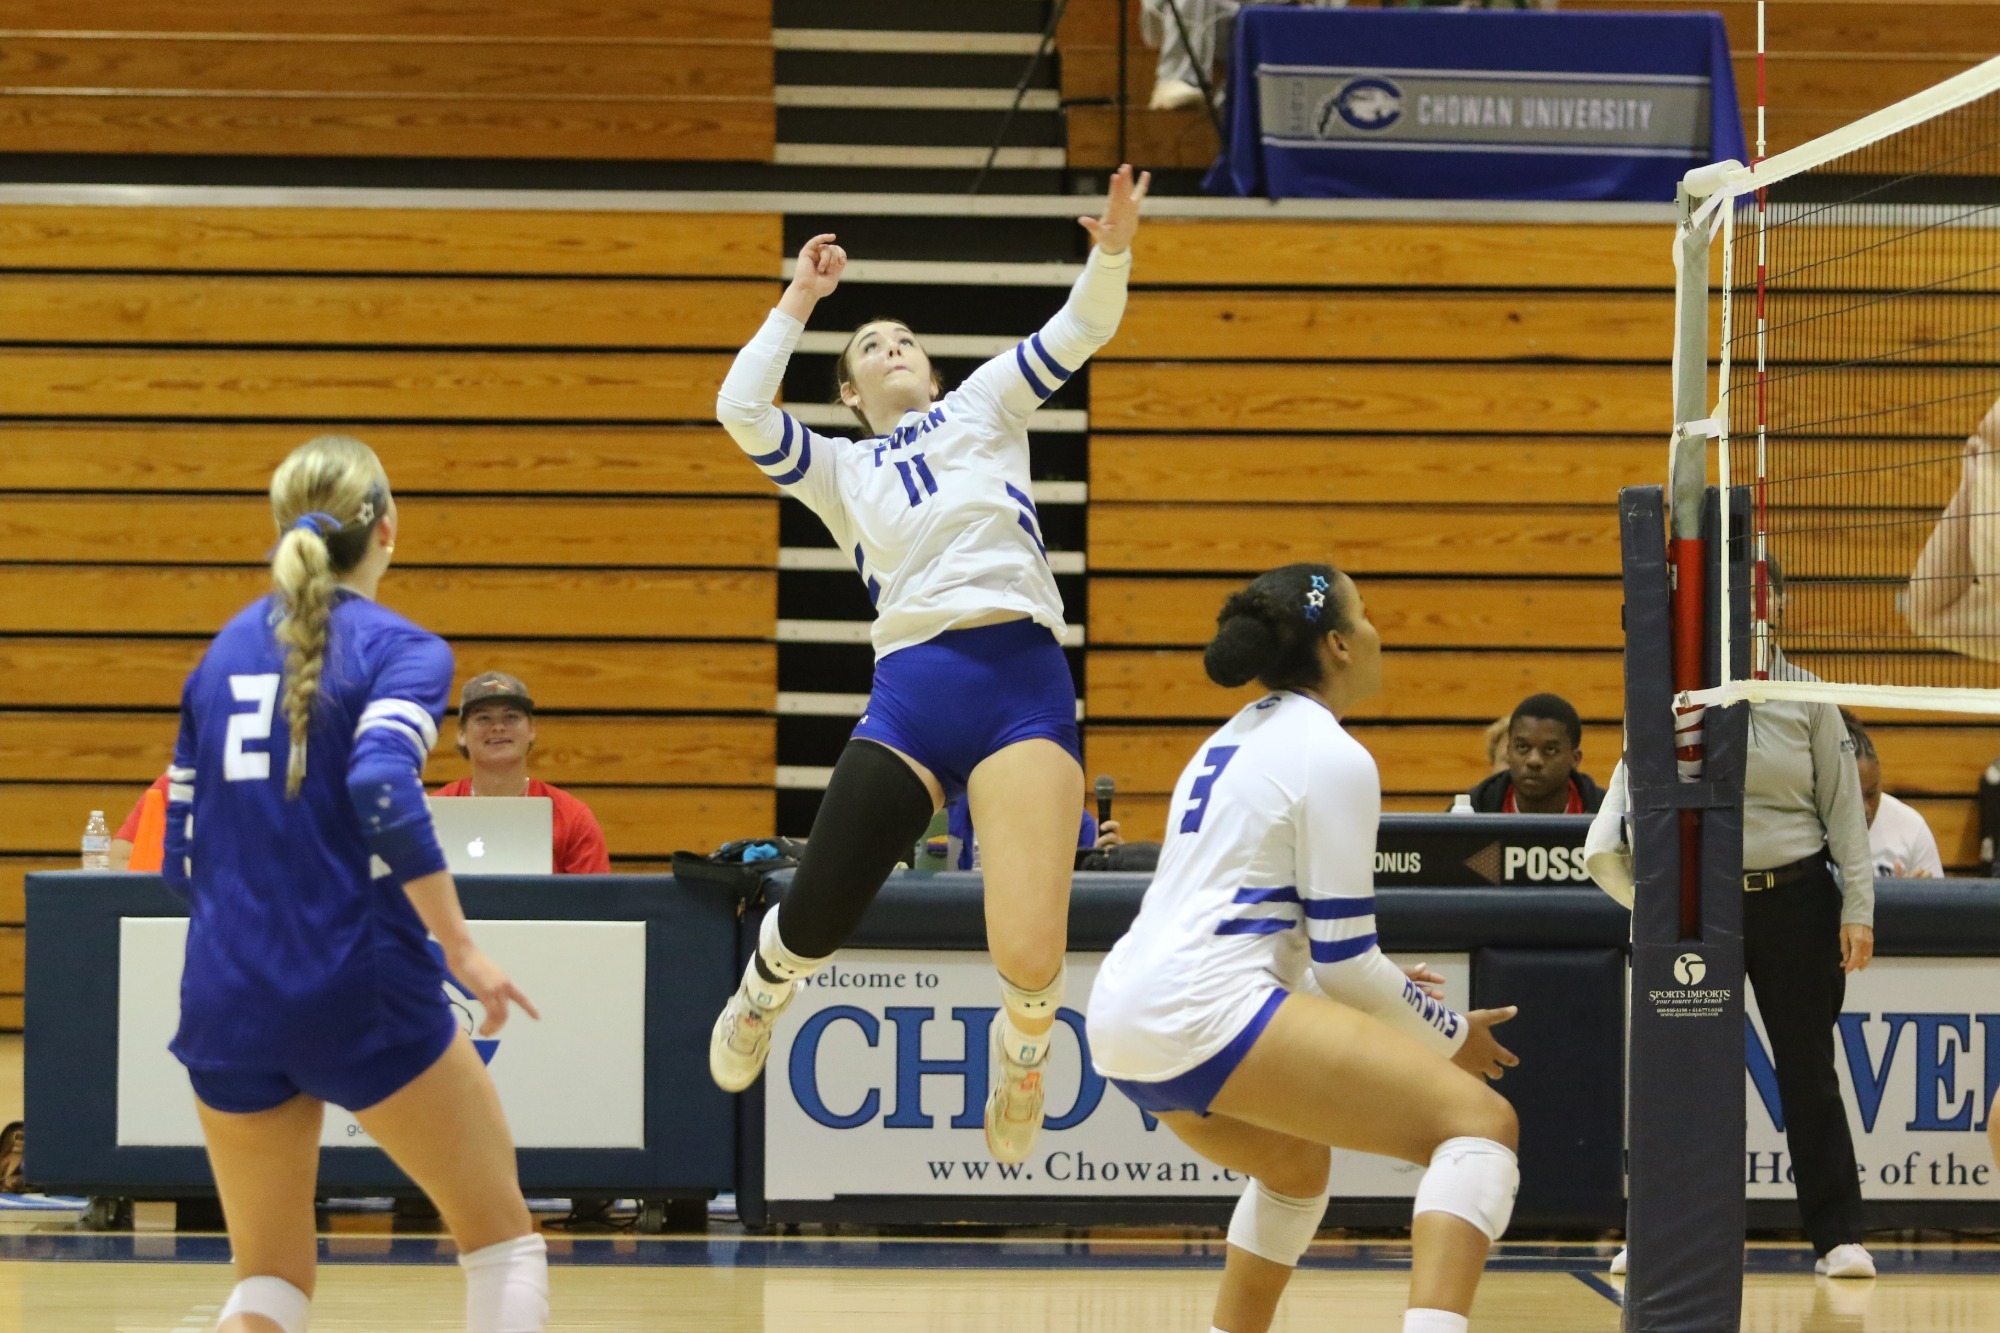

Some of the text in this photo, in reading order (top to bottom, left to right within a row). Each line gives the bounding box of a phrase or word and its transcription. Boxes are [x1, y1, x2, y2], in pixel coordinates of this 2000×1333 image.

[1417, 95, 1653, 131] CHOWAN UNIVERSITY
[894, 453, 938, 508] 11
[1179, 745, 1241, 834] 3
[1373, 851, 1421, 874] ONUS
[1504, 846, 1590, 882] POSS
[915, 971, 939, 988] to
[1649, 989, 1731, 1002] SPORTS IMPORTS
[1880, 1151, 1921, 1185] of
[1929, 1151, 1990, 1185] the
